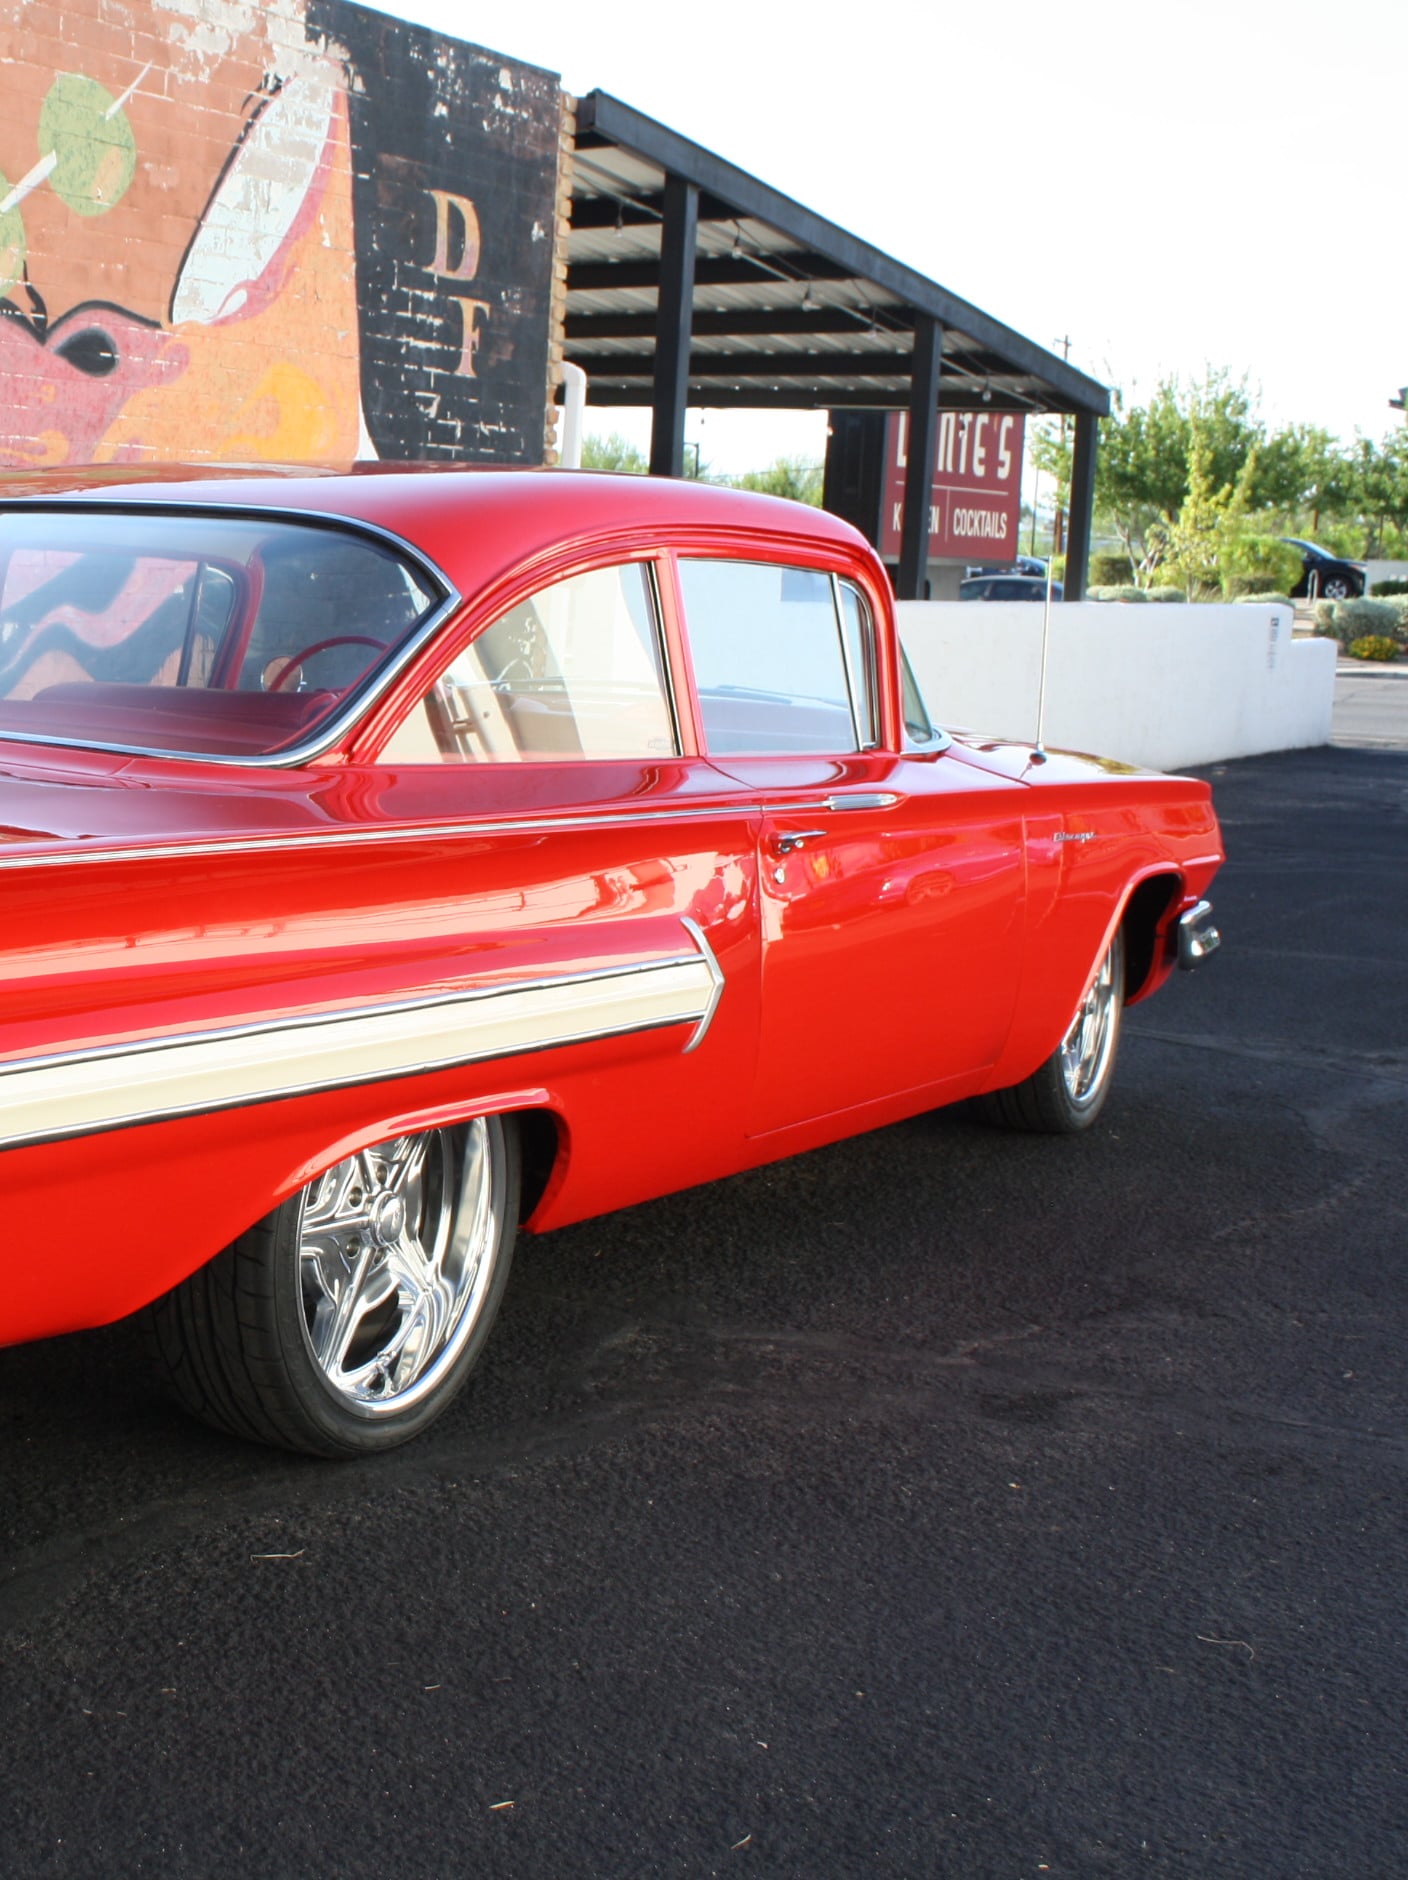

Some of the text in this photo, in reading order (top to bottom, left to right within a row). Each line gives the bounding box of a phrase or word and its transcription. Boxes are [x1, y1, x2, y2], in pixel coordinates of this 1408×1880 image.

[423, 189, 481, 281] D
[449, 296, 491, 378] F
[897, 411, 1014, 479] NTE'S
[953, 508, 1008, 539] COCKTAILS
